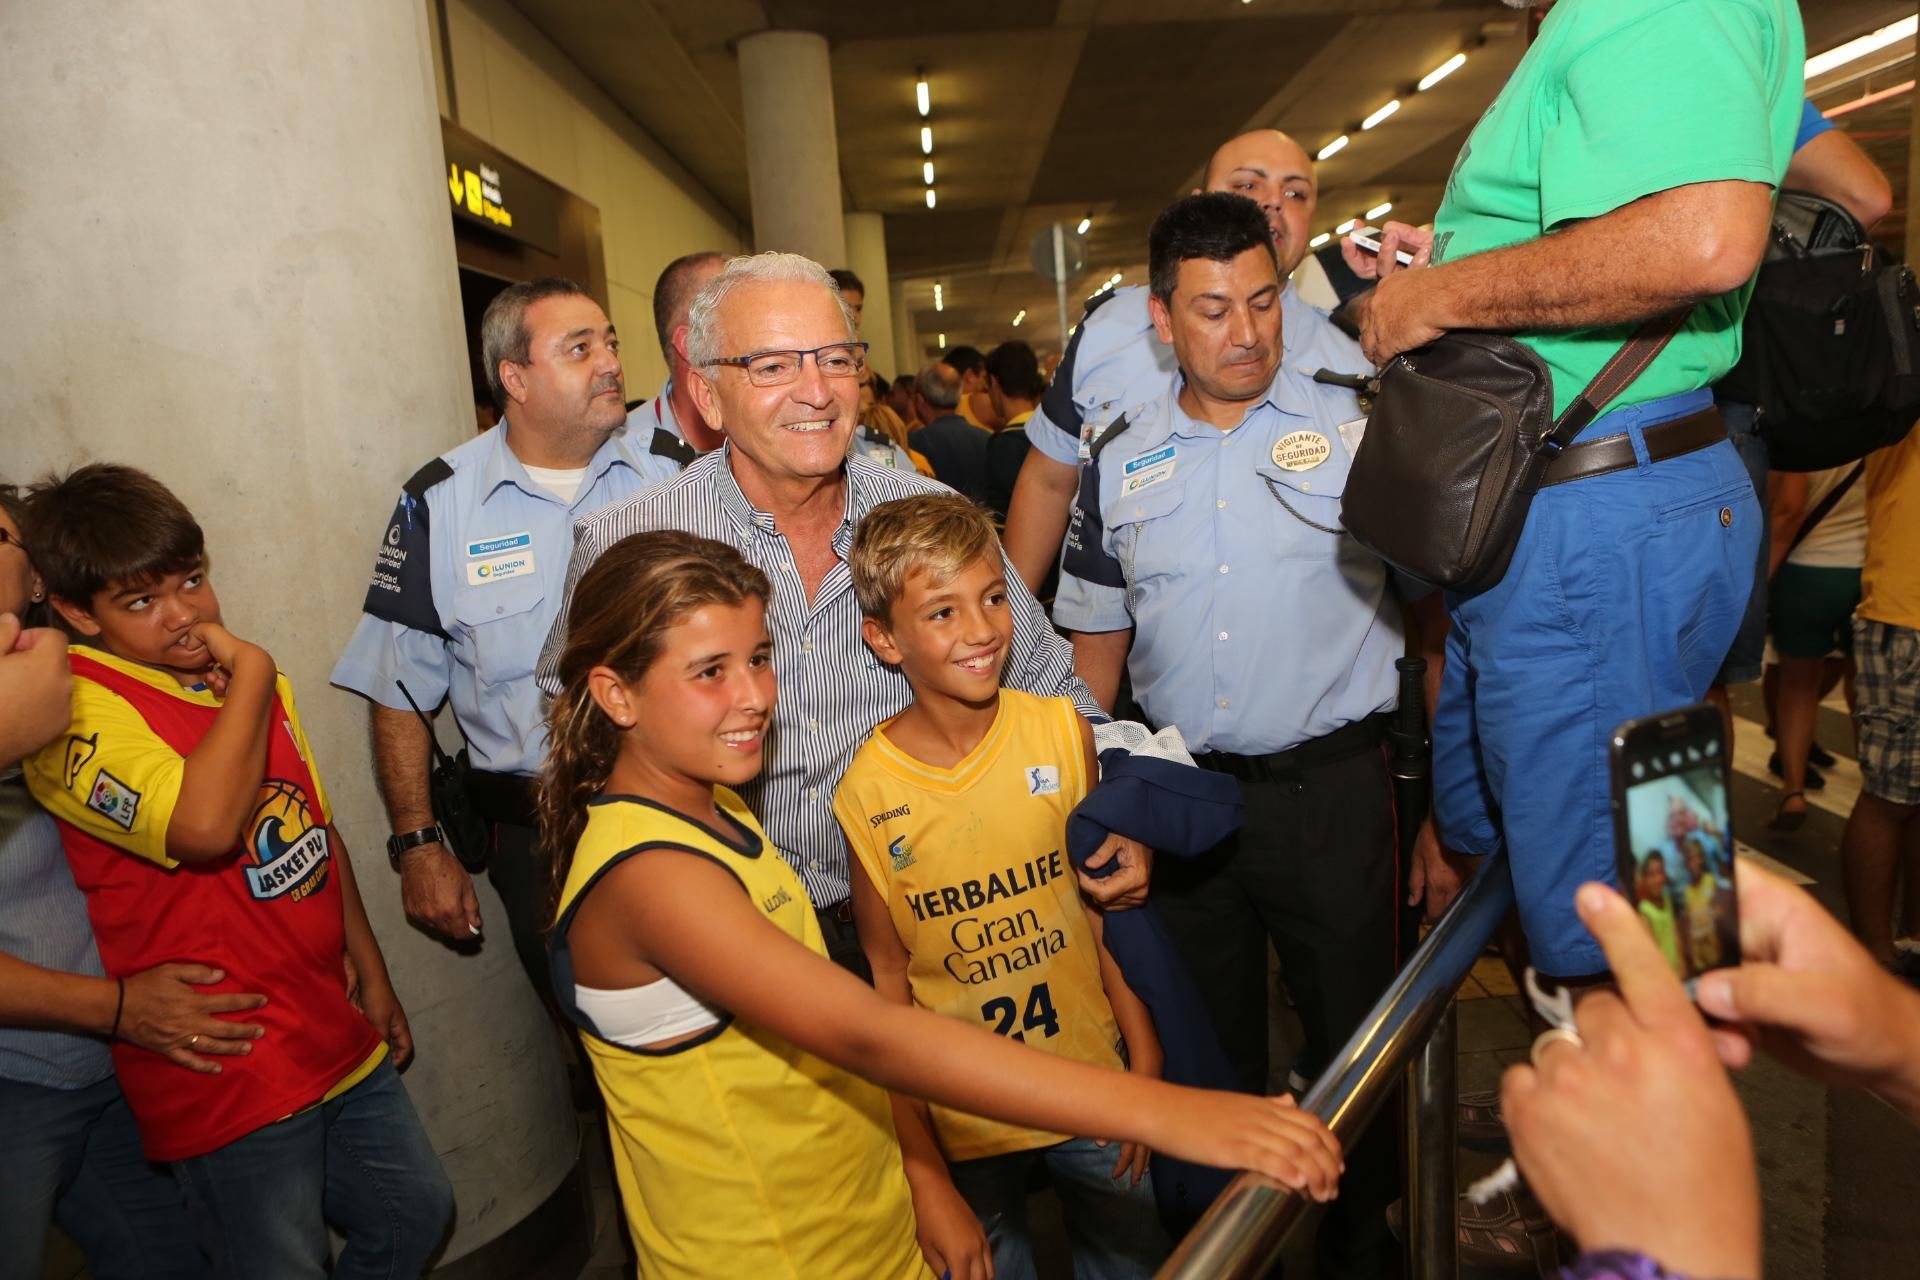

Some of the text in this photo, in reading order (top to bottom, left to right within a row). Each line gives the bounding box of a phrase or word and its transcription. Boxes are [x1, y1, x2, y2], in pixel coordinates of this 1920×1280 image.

[1275, 433, 1322, 450] VIGILANTE
[1132, 450, 1167, 469] Seguridad
[1275, 445, 1327, 462] SEGURIDAD
[479, 538, 519, 551] Seguridad
[491, 559, 526, 573] ILUNION
[120, 797, 132, 820] LFP
[870, 803, 911, 829] SPALDING
[904, 850, 1064, 922] HERBALIFE
[950, 908, 1040, 954] Gran
[943, 926, 1068, 985] Canaria
[981, 982, 1060, 1045] 24
